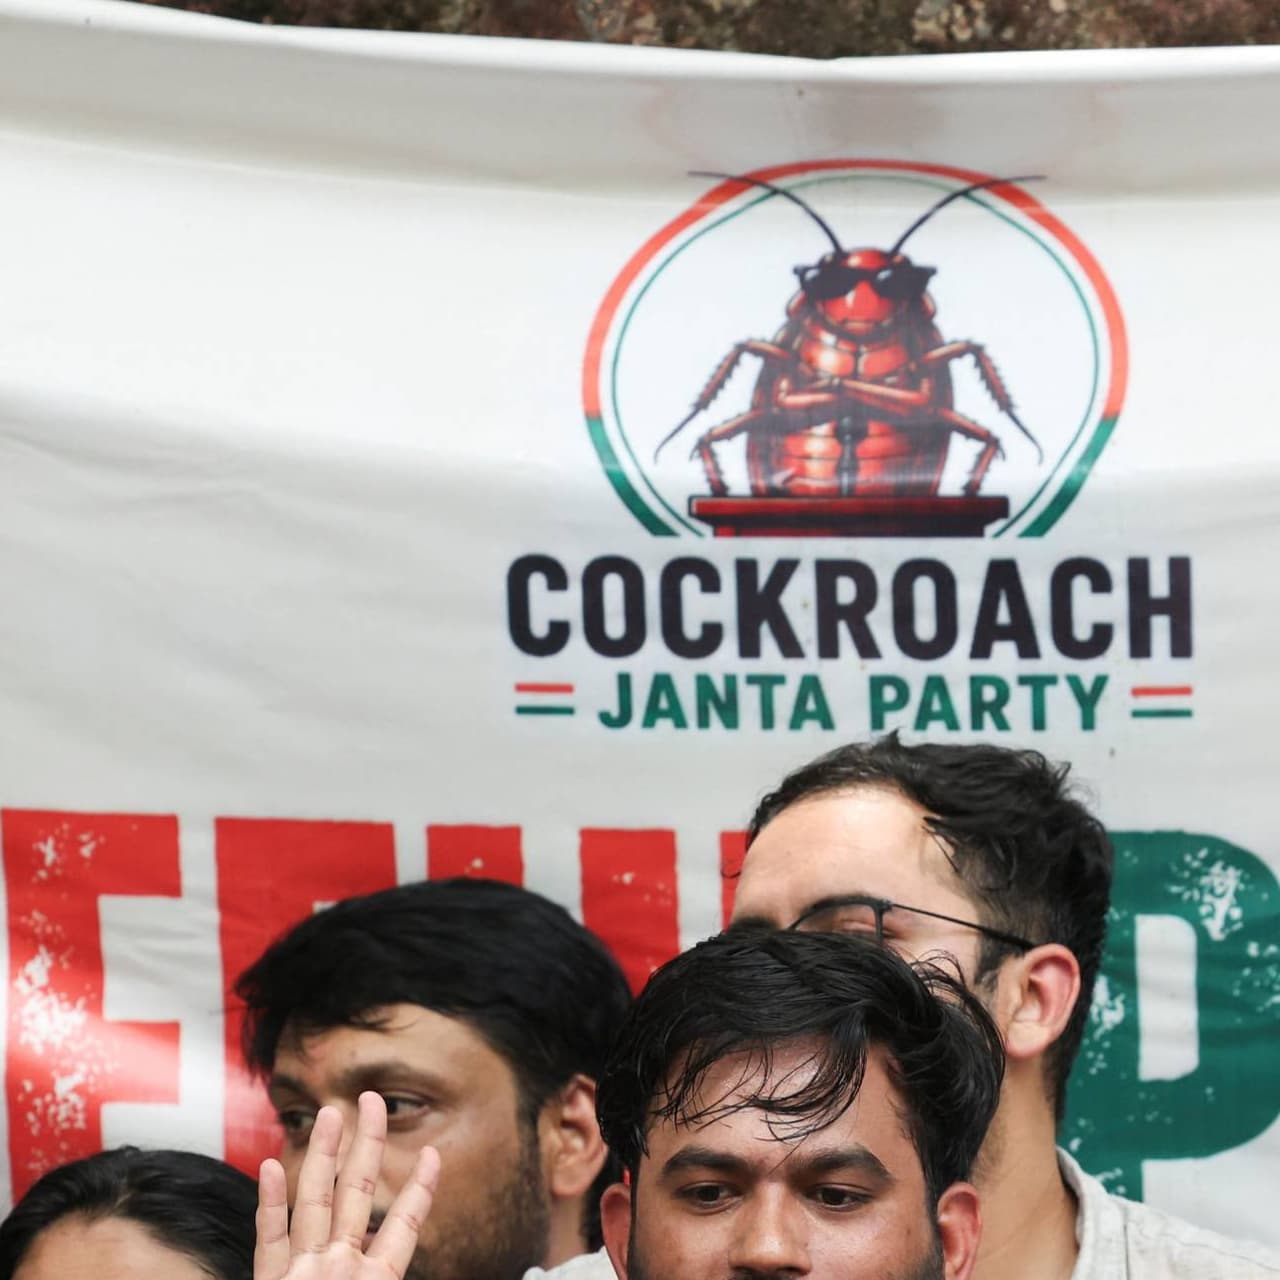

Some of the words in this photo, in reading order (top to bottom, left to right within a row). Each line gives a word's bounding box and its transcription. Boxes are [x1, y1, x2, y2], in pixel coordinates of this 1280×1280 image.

[506, 553, 1194, 661] COCKROACH
[598, 672, 836, 731] JANTA
[869, 672, 1110, 732] PARTY
